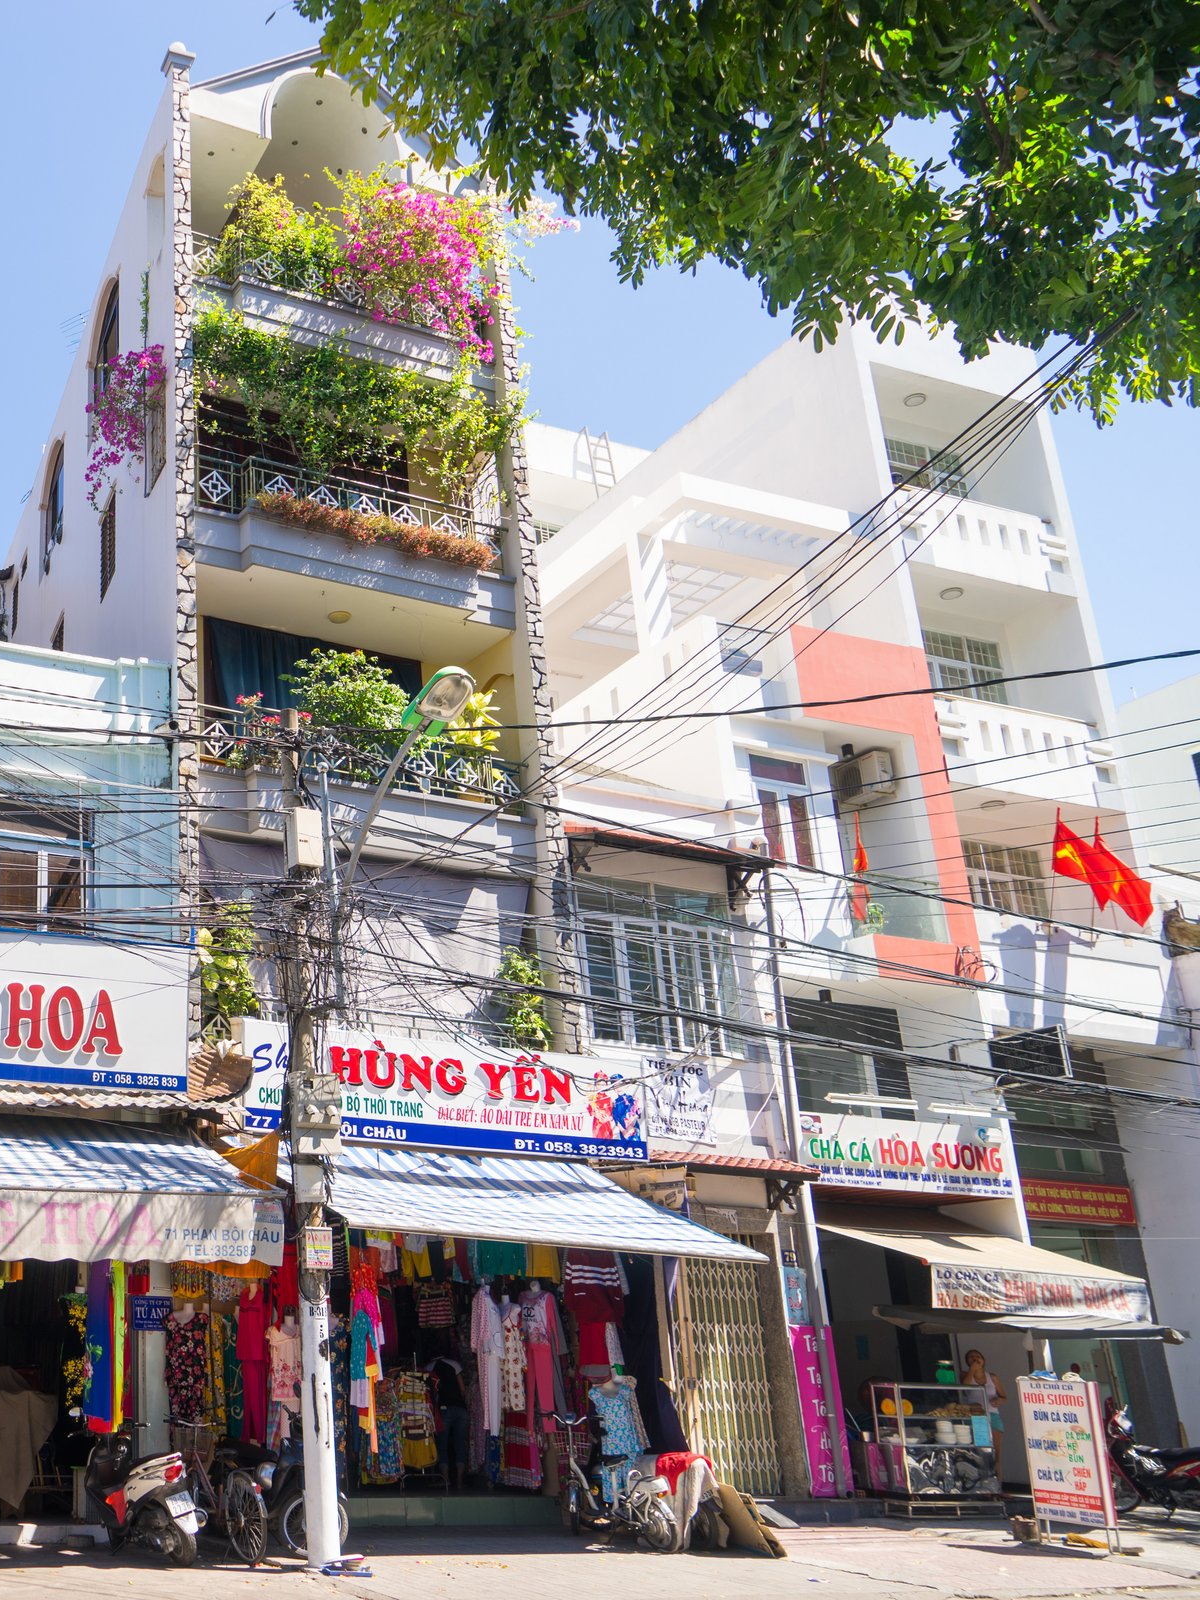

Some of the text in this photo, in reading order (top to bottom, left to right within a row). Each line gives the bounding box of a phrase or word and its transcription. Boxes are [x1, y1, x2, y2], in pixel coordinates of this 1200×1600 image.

[5, 981, 123, 1057] HOA
[115, 1074, 134, 1084] 058.
[137, 1076, 159, 1086] 3825
[162, 1077, 178, 1087] 839
[330, 1040, 467, 1097] HÙNG
[478, 1055, 571, 1106] YẾN
[346, 1092, 360, 1116] BỘ
[364, 1095, 387, 1115] THỜI
[390, 1100, 423, 1118] TRANG
[500, 1105, 512, 1126] DÀI
[514, 1107, 532, 1127] TRẺ
[534, 1114, 548, 1128] EM
[549, 1114, 569, 1131] NAM
[251, 1115, 406, 1140] 77 ỘI CHÂU
[514, 1138, 643, 1159] ĐT: 058.3823943
[849, 1137, 873, 1163] CÁ
[879, 1134, 926, 1167] HÒA
[931, 1142, 1004, 1173] SƯƠNG
[38, 1200, 162, 1247] HOA
[165, 1226, 280, 1244] 71 PHAN BỘI CHÂU
[136, 1304, 148, 1318] TÚ
